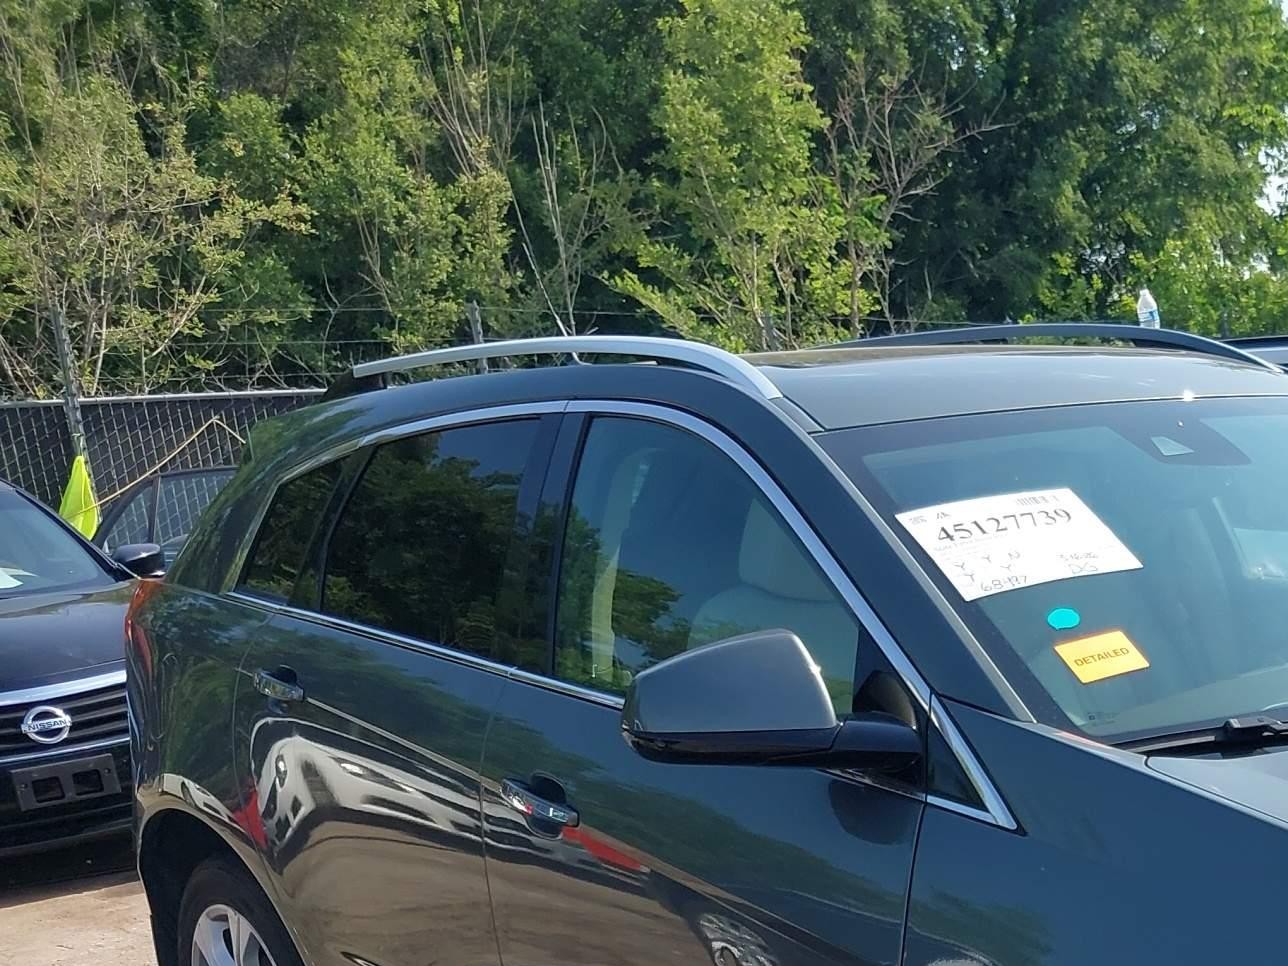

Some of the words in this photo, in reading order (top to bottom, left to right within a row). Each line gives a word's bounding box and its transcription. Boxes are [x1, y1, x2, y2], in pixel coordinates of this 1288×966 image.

[937, 508, 1072, 542] 45127739
[1074, 647, 1130, 667] DETAILED
[28, 719, 66, 731] NISSAN
